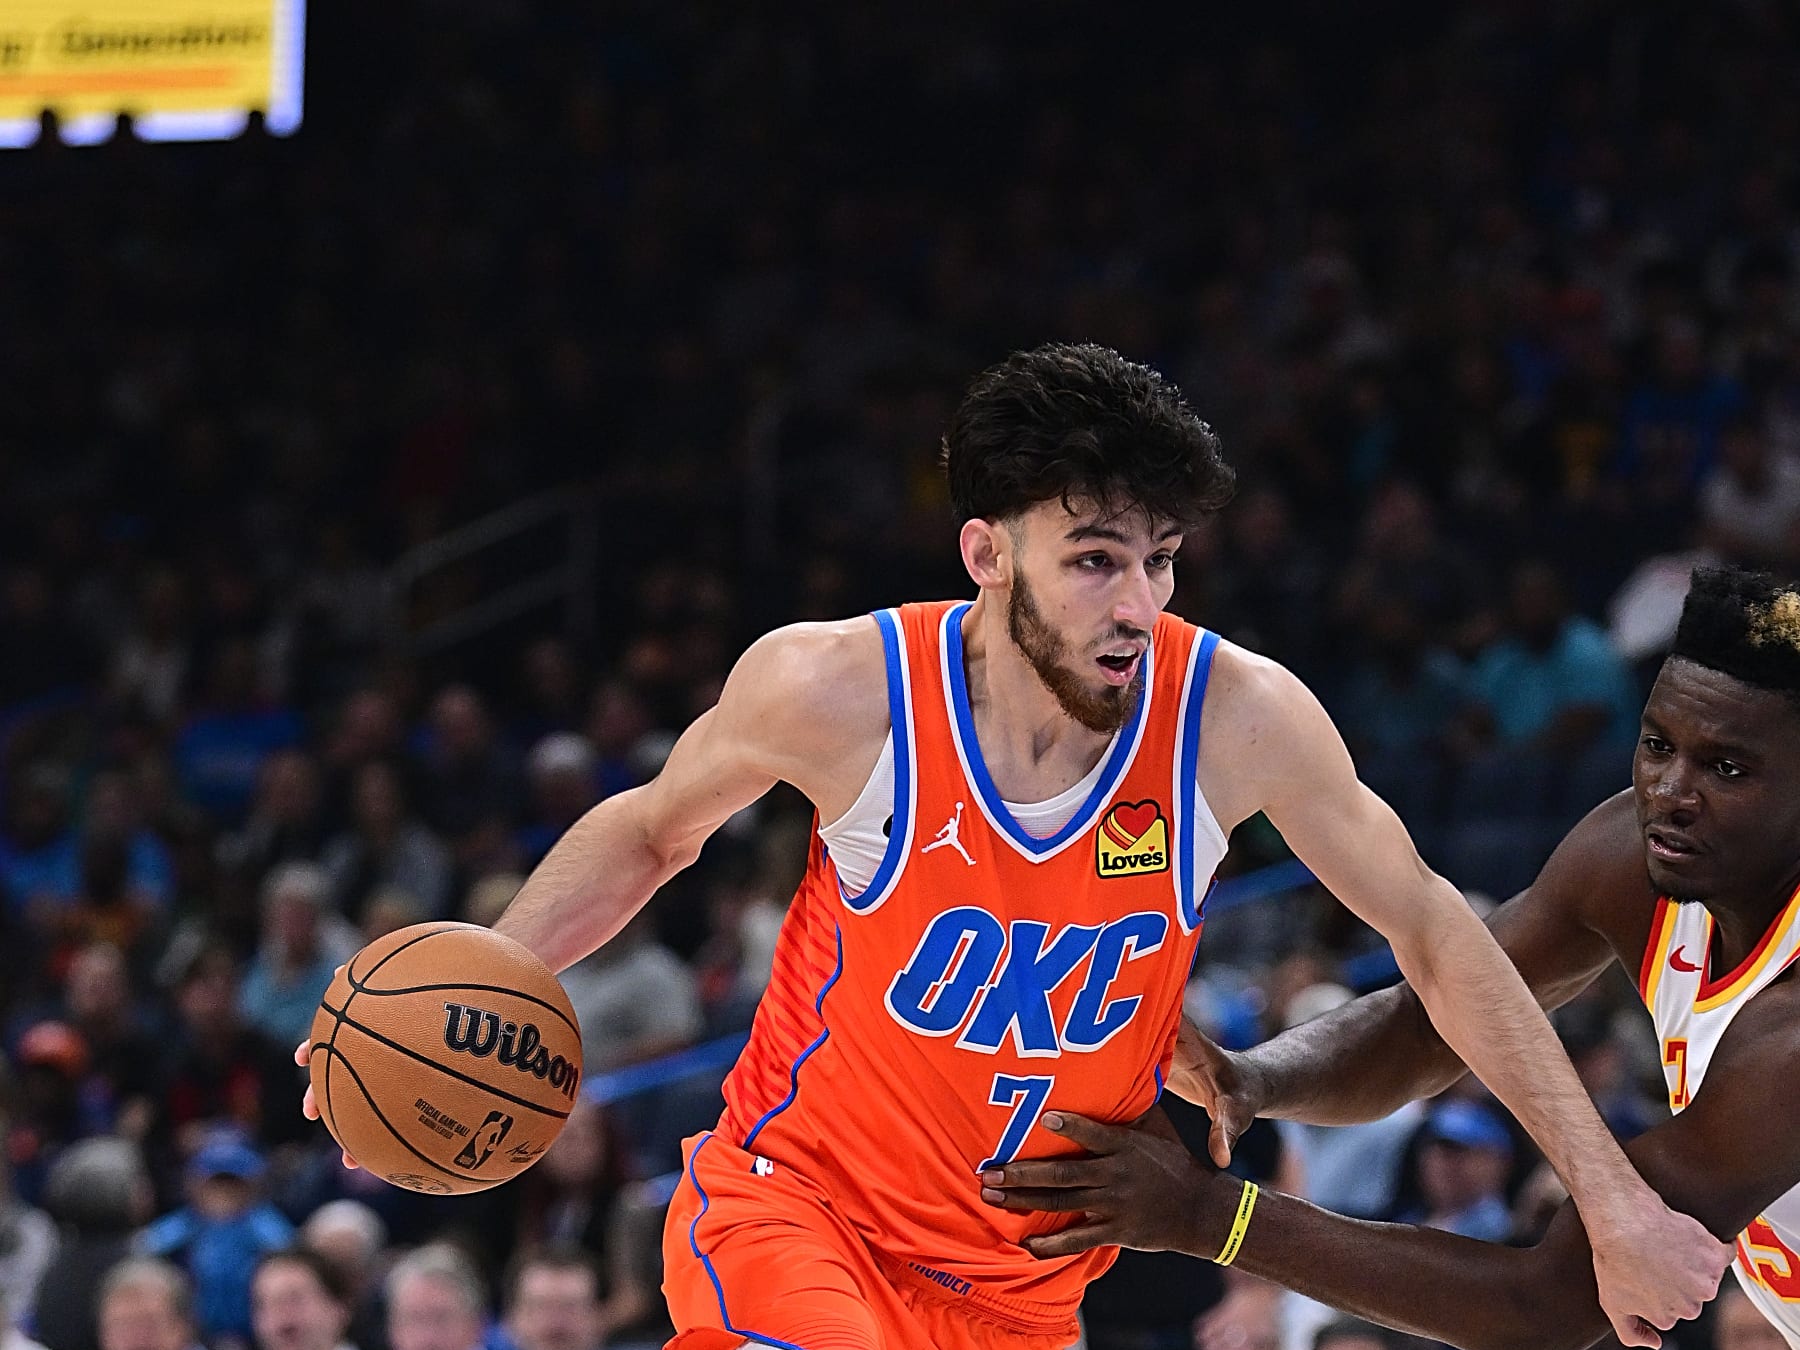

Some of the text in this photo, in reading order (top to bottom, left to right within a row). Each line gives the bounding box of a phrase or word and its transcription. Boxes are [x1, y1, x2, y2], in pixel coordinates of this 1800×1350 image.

[884, 906, 1169, 1058] OKC
[444, 1002, 578, 1101] Wilson
[976, 1073, 1054, 1173] 7
